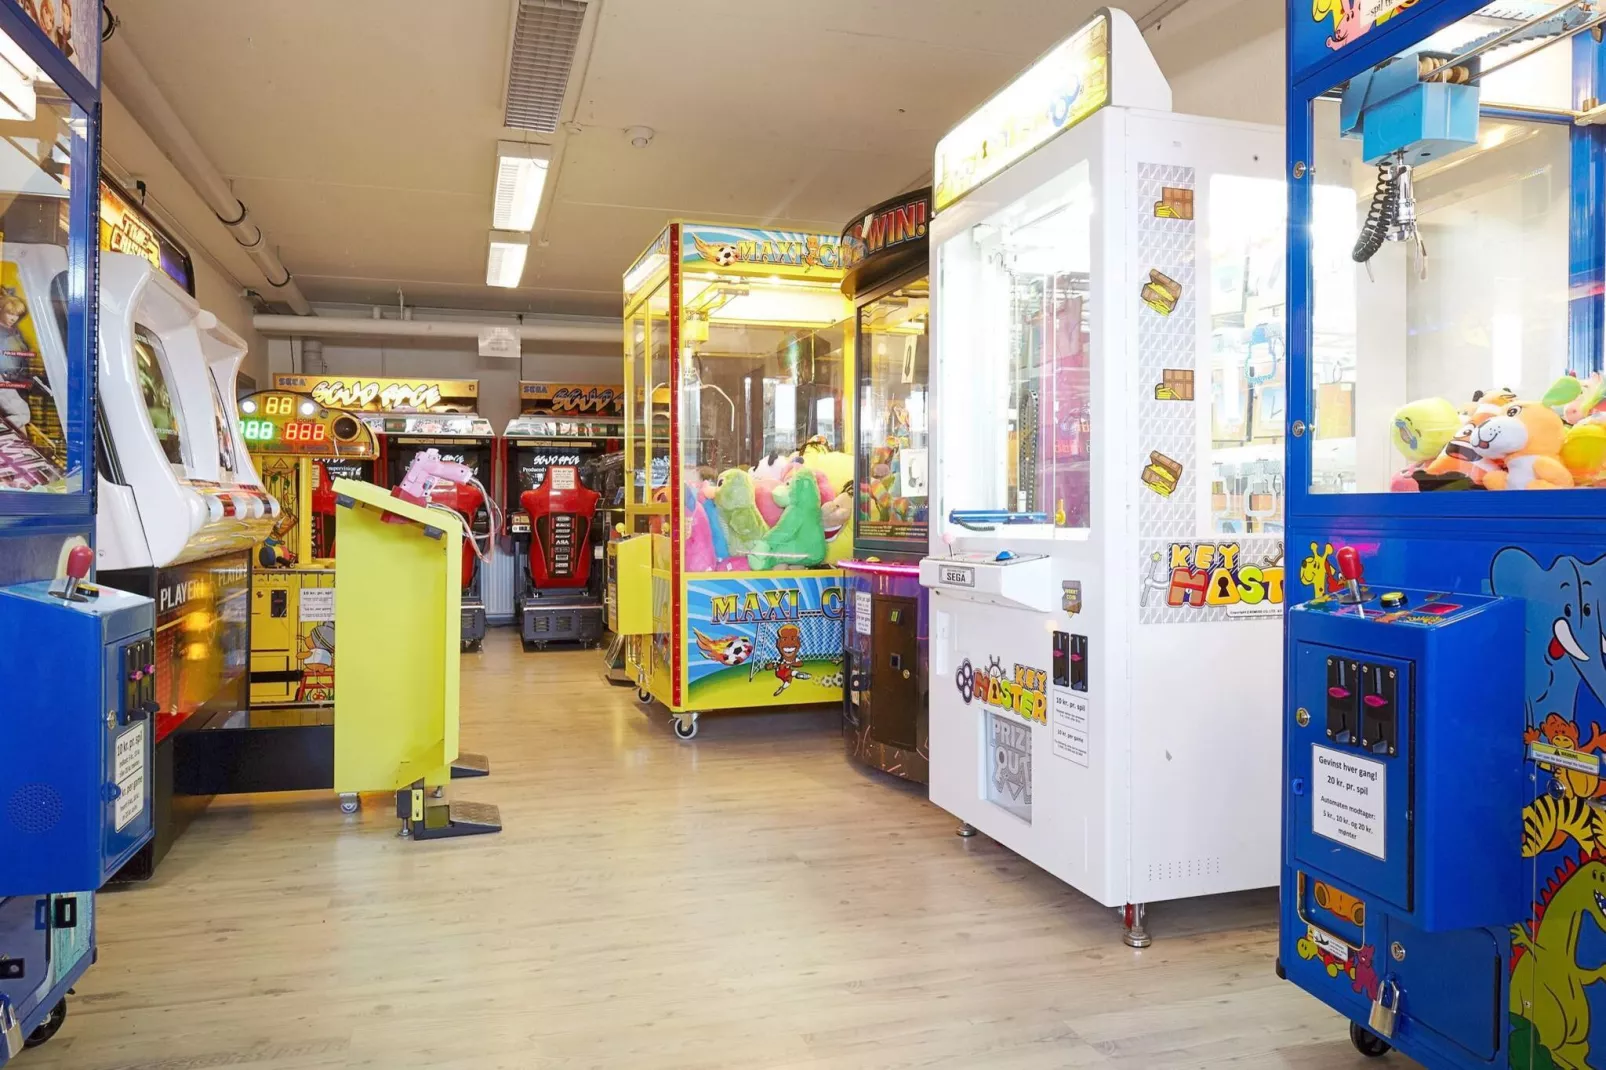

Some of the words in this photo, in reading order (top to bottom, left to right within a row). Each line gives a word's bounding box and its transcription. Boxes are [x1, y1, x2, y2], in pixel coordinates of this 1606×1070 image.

[867, 201, 928, 251] WIN!
[737, 241, 802, 266] MAXI
[523, 386, 548, 394] SEGA
[1170, 543, 1240, 570] KEY
[947, 572, 966, 582] SEGA
[160, 579, 200, 612] PLAYER
[711, 588, 801, 625] MAXI
[1014, 664, 1047, 693] KEY
[973, 668, 1047, 725] MASTER
[1319, 755, 1342, 770] Gevinst
[1343, 762, 1358, 774] hver
[1359, 769, 1378, 782] gang!
[1327, 775, 1335, 785] 20
[1336, 778, 1345, 788] kr.
[1346, 782, 1355, 792] pr.
[1356, 786, 1368, 796] spil
[1320, 795, 1349, 810] Automaten
[1349, 805, 1376, 820] modtager:
[1336, 815, 1343, 823] 10
[1351, 822, 1358, 830] og
[1358, 823, 1365, 831] 20
